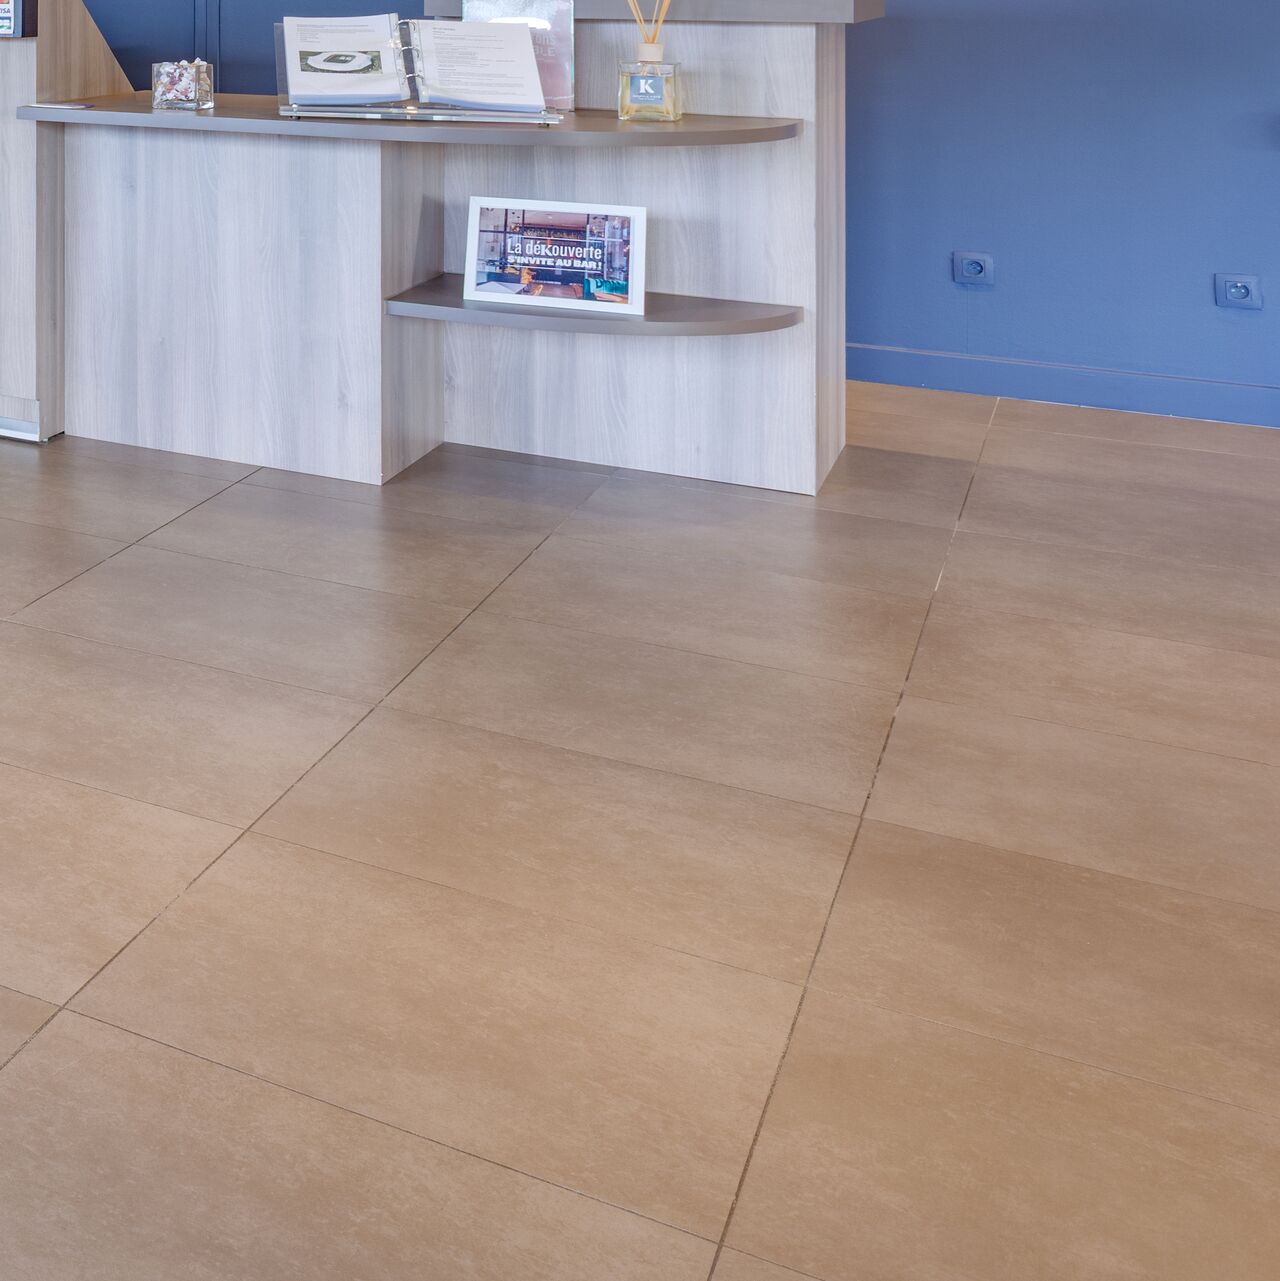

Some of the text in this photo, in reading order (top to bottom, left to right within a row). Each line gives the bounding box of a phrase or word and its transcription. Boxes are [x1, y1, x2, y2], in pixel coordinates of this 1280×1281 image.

[640, 79, 654, 94] K
[507, 239, 521, 254] La
[507, 256, 554, 266] S'INVITE
[555, 258, 572, 268] AU
